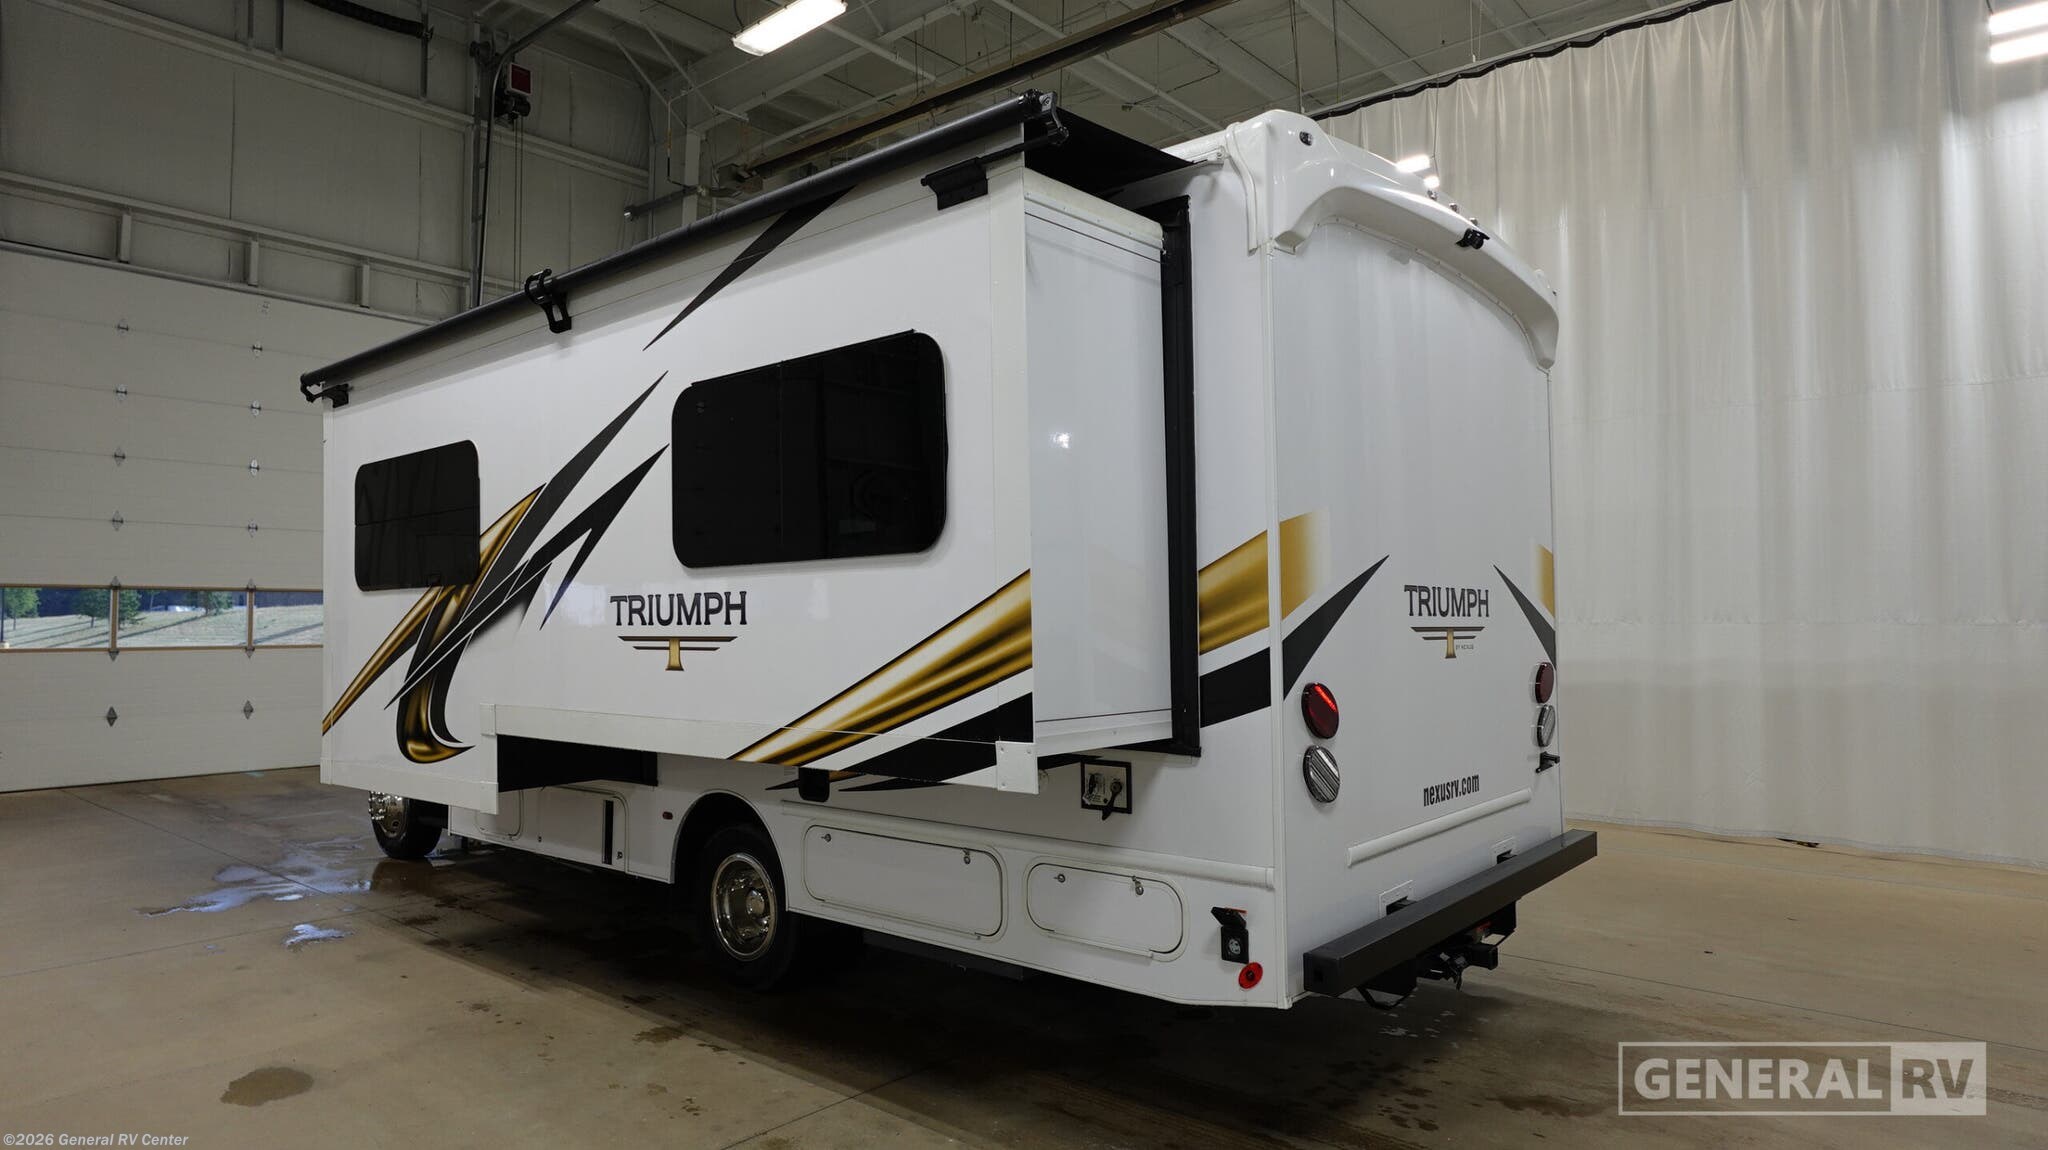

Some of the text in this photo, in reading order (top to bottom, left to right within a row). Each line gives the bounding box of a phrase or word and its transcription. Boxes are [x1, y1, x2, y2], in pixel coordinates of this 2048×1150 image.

[610, 591, 747, 626] TRIUMPH
[1404, 585, 1489, 618] TRIUMPH
[1423, 774, 1480, 807] nexusrv.com
